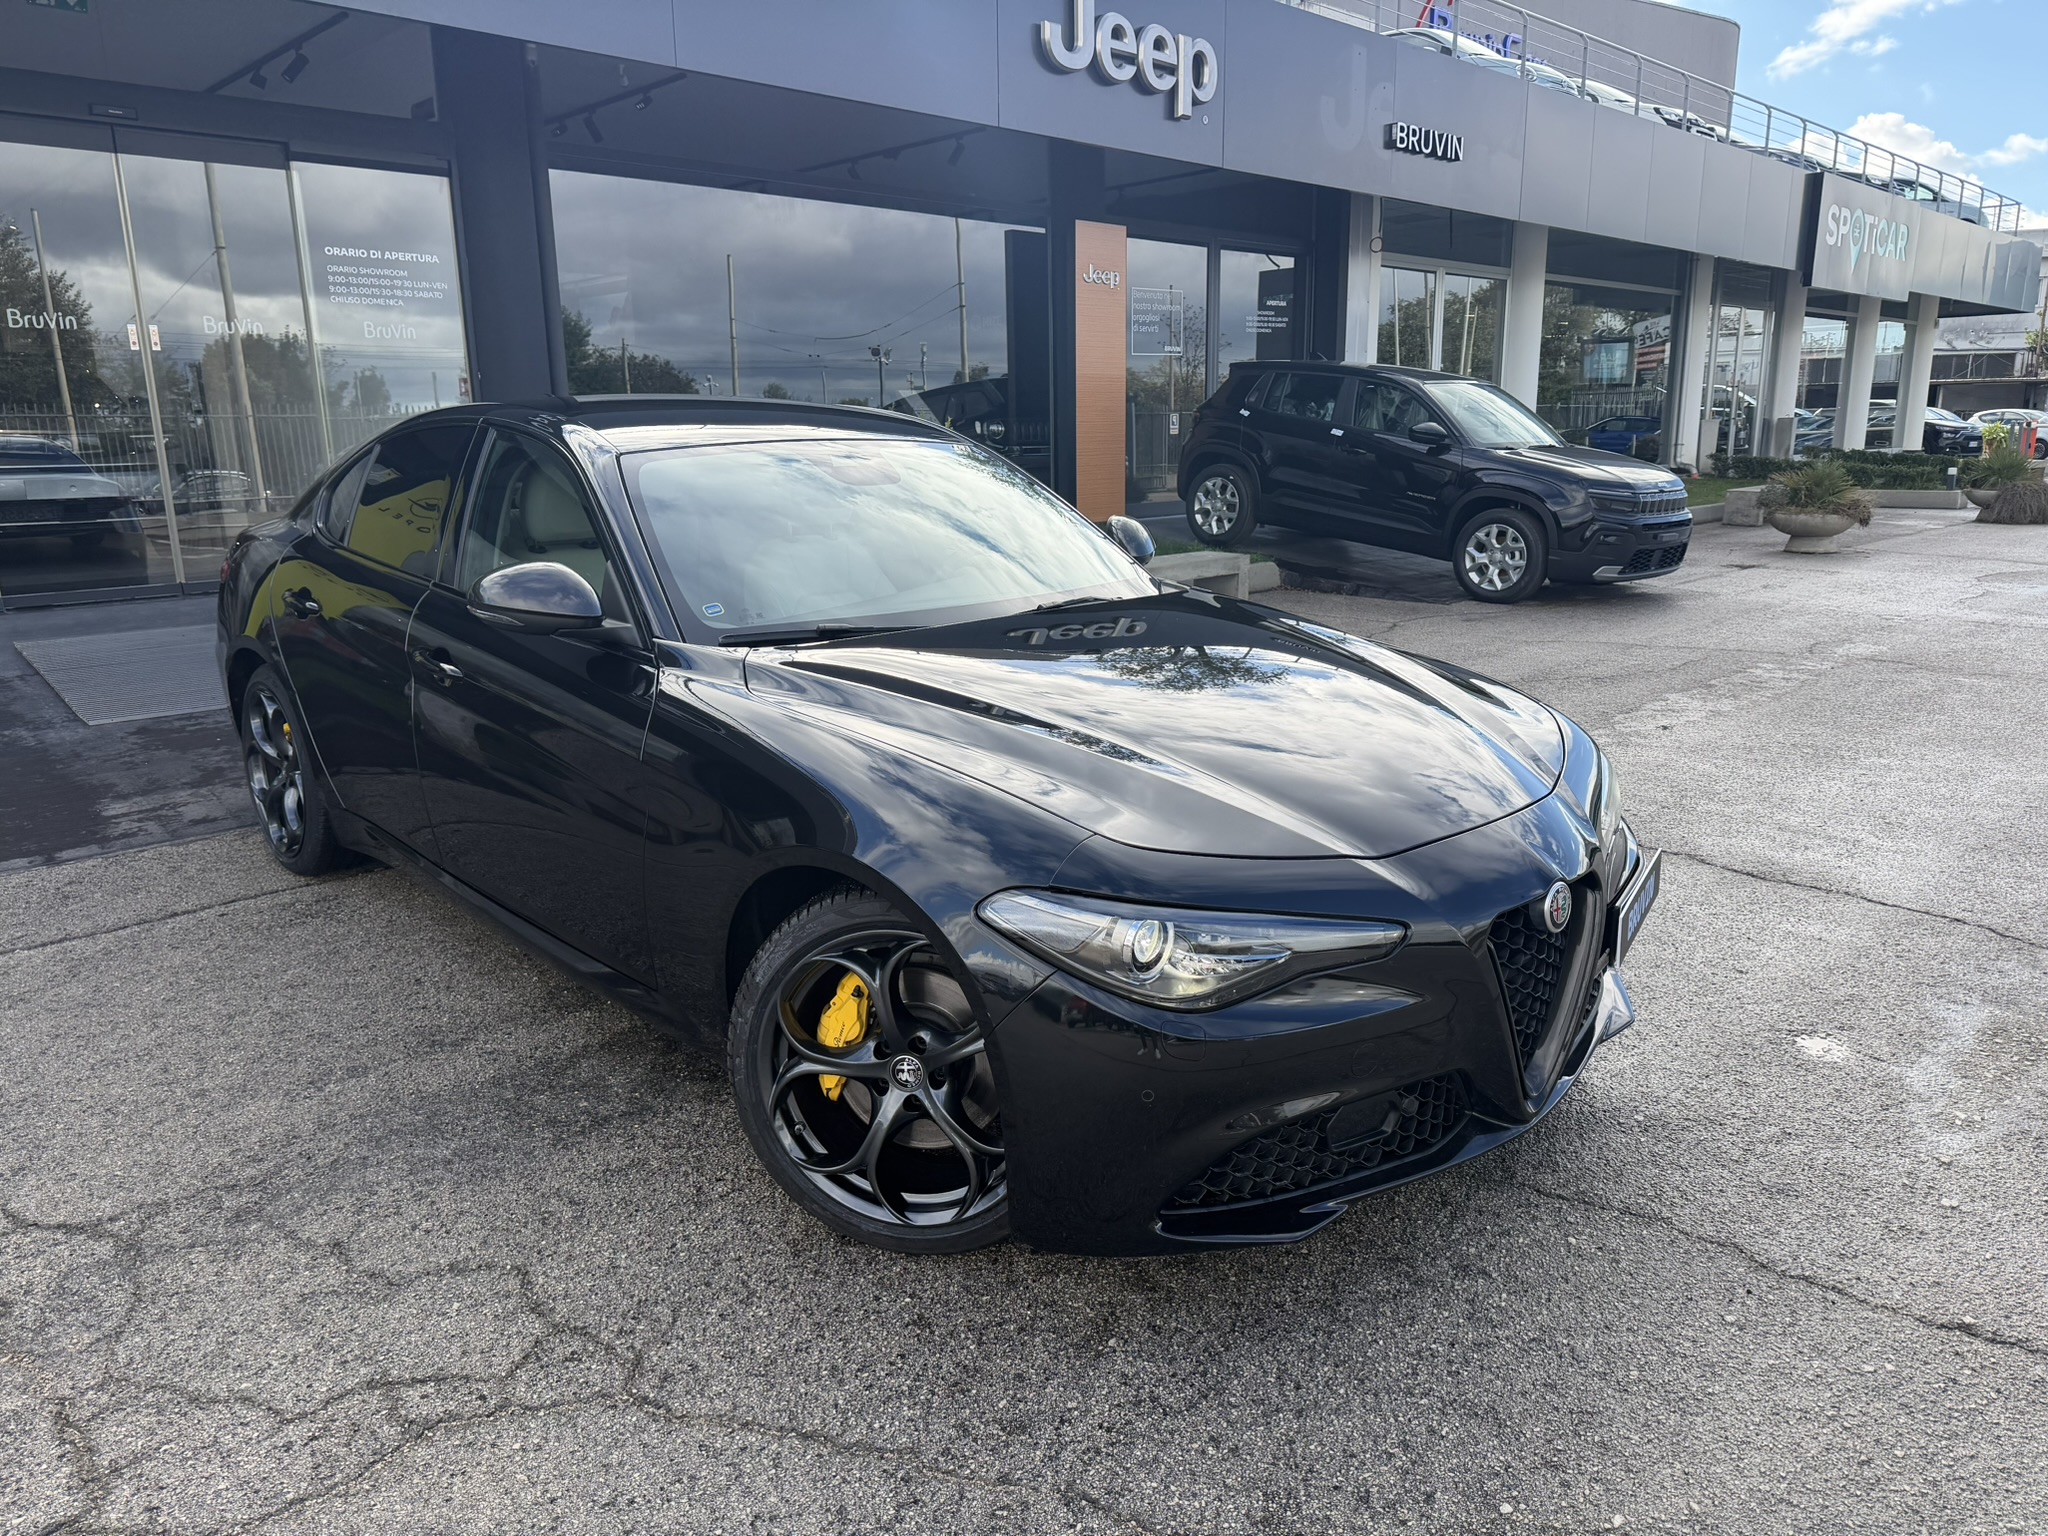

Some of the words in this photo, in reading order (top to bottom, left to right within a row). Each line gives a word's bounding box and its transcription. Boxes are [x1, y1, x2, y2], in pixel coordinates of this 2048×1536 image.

[1041, 0, 1217, 119] Jeep
[1396, 121, 1464, 161] BRUVIN
[324, 246, 368, 258] ORARIO
[370, 250, 382, 259] DI
[384, 252, 440, 263] APERTURA
[327, 265, 358, 274] ORARIO
[359, 267, 408, 277] SHOWROOM
[1083, 263, 1120, 288] Jeep
[413, 280, 448, 289] LUN-VEN
[330, 295, 360, 305] CHIUSO
[414, 290, 443, 299] SABATO
[1133, 290, 1163, 300] Benvenuto
[1132, 302, 1152, 310] nostro
[6, 308, 78, 331] BruVin
[1132, 313, 1161, 324] orgogliosi
[203, 315, 264, 335] BruVin
[363, 321, 417, 340] BruVin
[1133, 324, 1139, 332] di
[1139, 325, 1160, 333] servirti
